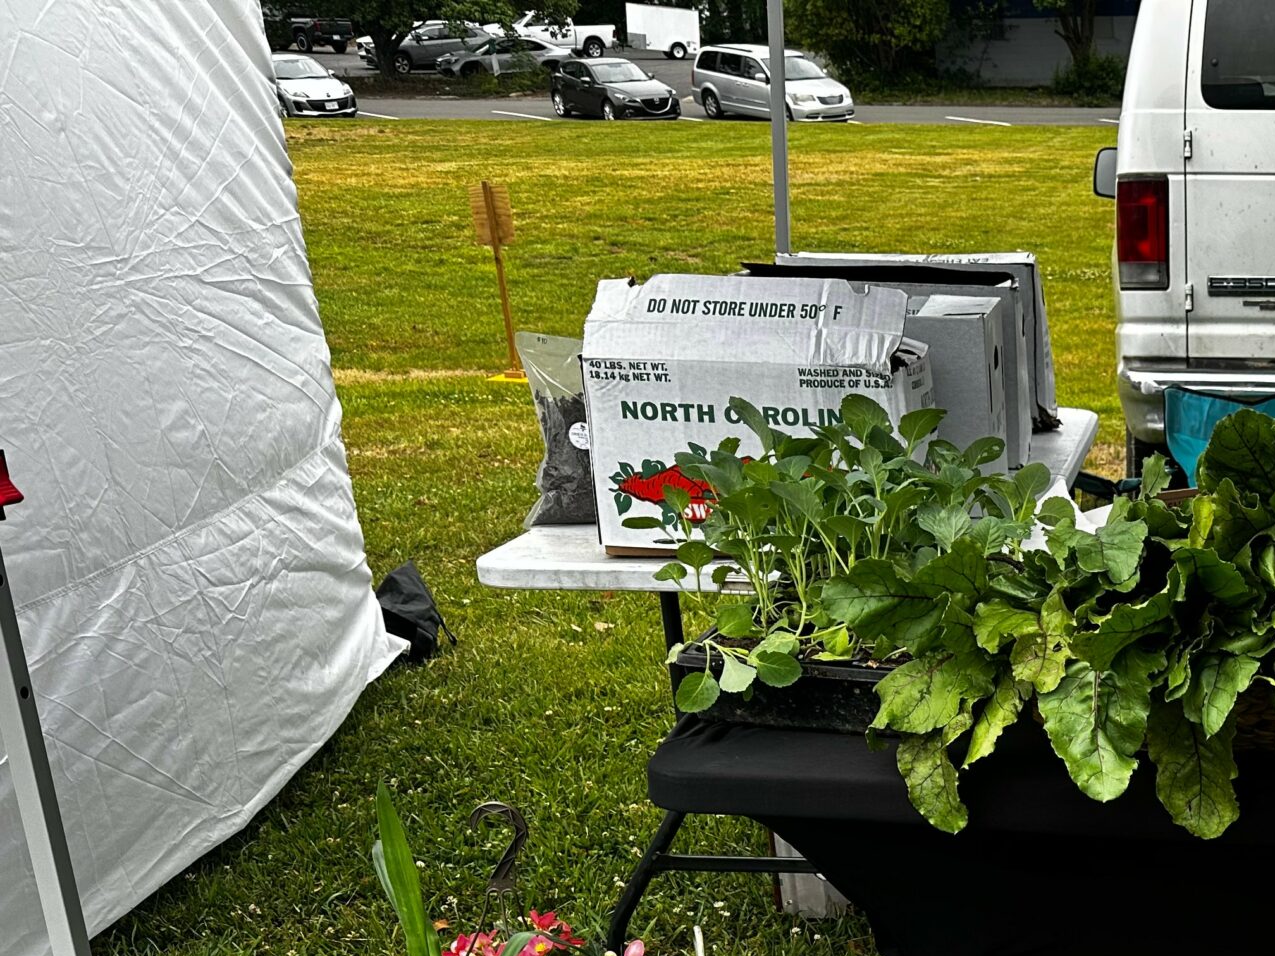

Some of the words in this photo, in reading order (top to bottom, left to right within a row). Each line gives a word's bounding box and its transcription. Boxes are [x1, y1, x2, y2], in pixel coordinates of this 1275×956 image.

[646, 298, 667, 313] DO
[670, 299, 699, 314] NOT
[702, 300, 746, 316] STORE
[749, 302, 796, 319] UNDER
[833, 305, 842, 320] F
[589, 361, 601, 369] 40
[604, 361, 626, 370] LBS.
[629, 362, 647, 370] NET
[651, 363, 668, 371] WT.
[589, 370, 616, 380] 18.14
[619, 371, 630, 382] kg
[632, 372, 651, 381] NET
[654, 373, 671, 382] WT.
[798, 368, 839, 378] WASHED
[842, 368, 863, 377] AND
[799, 379, 846, 388] PRODUCE
[848, 379, 861, 388] OF
[864, 379, 893, 389] U.S.A.
[620, 401, 716, 424] NORTH
[724, 405, 844, 427] CROLIN
